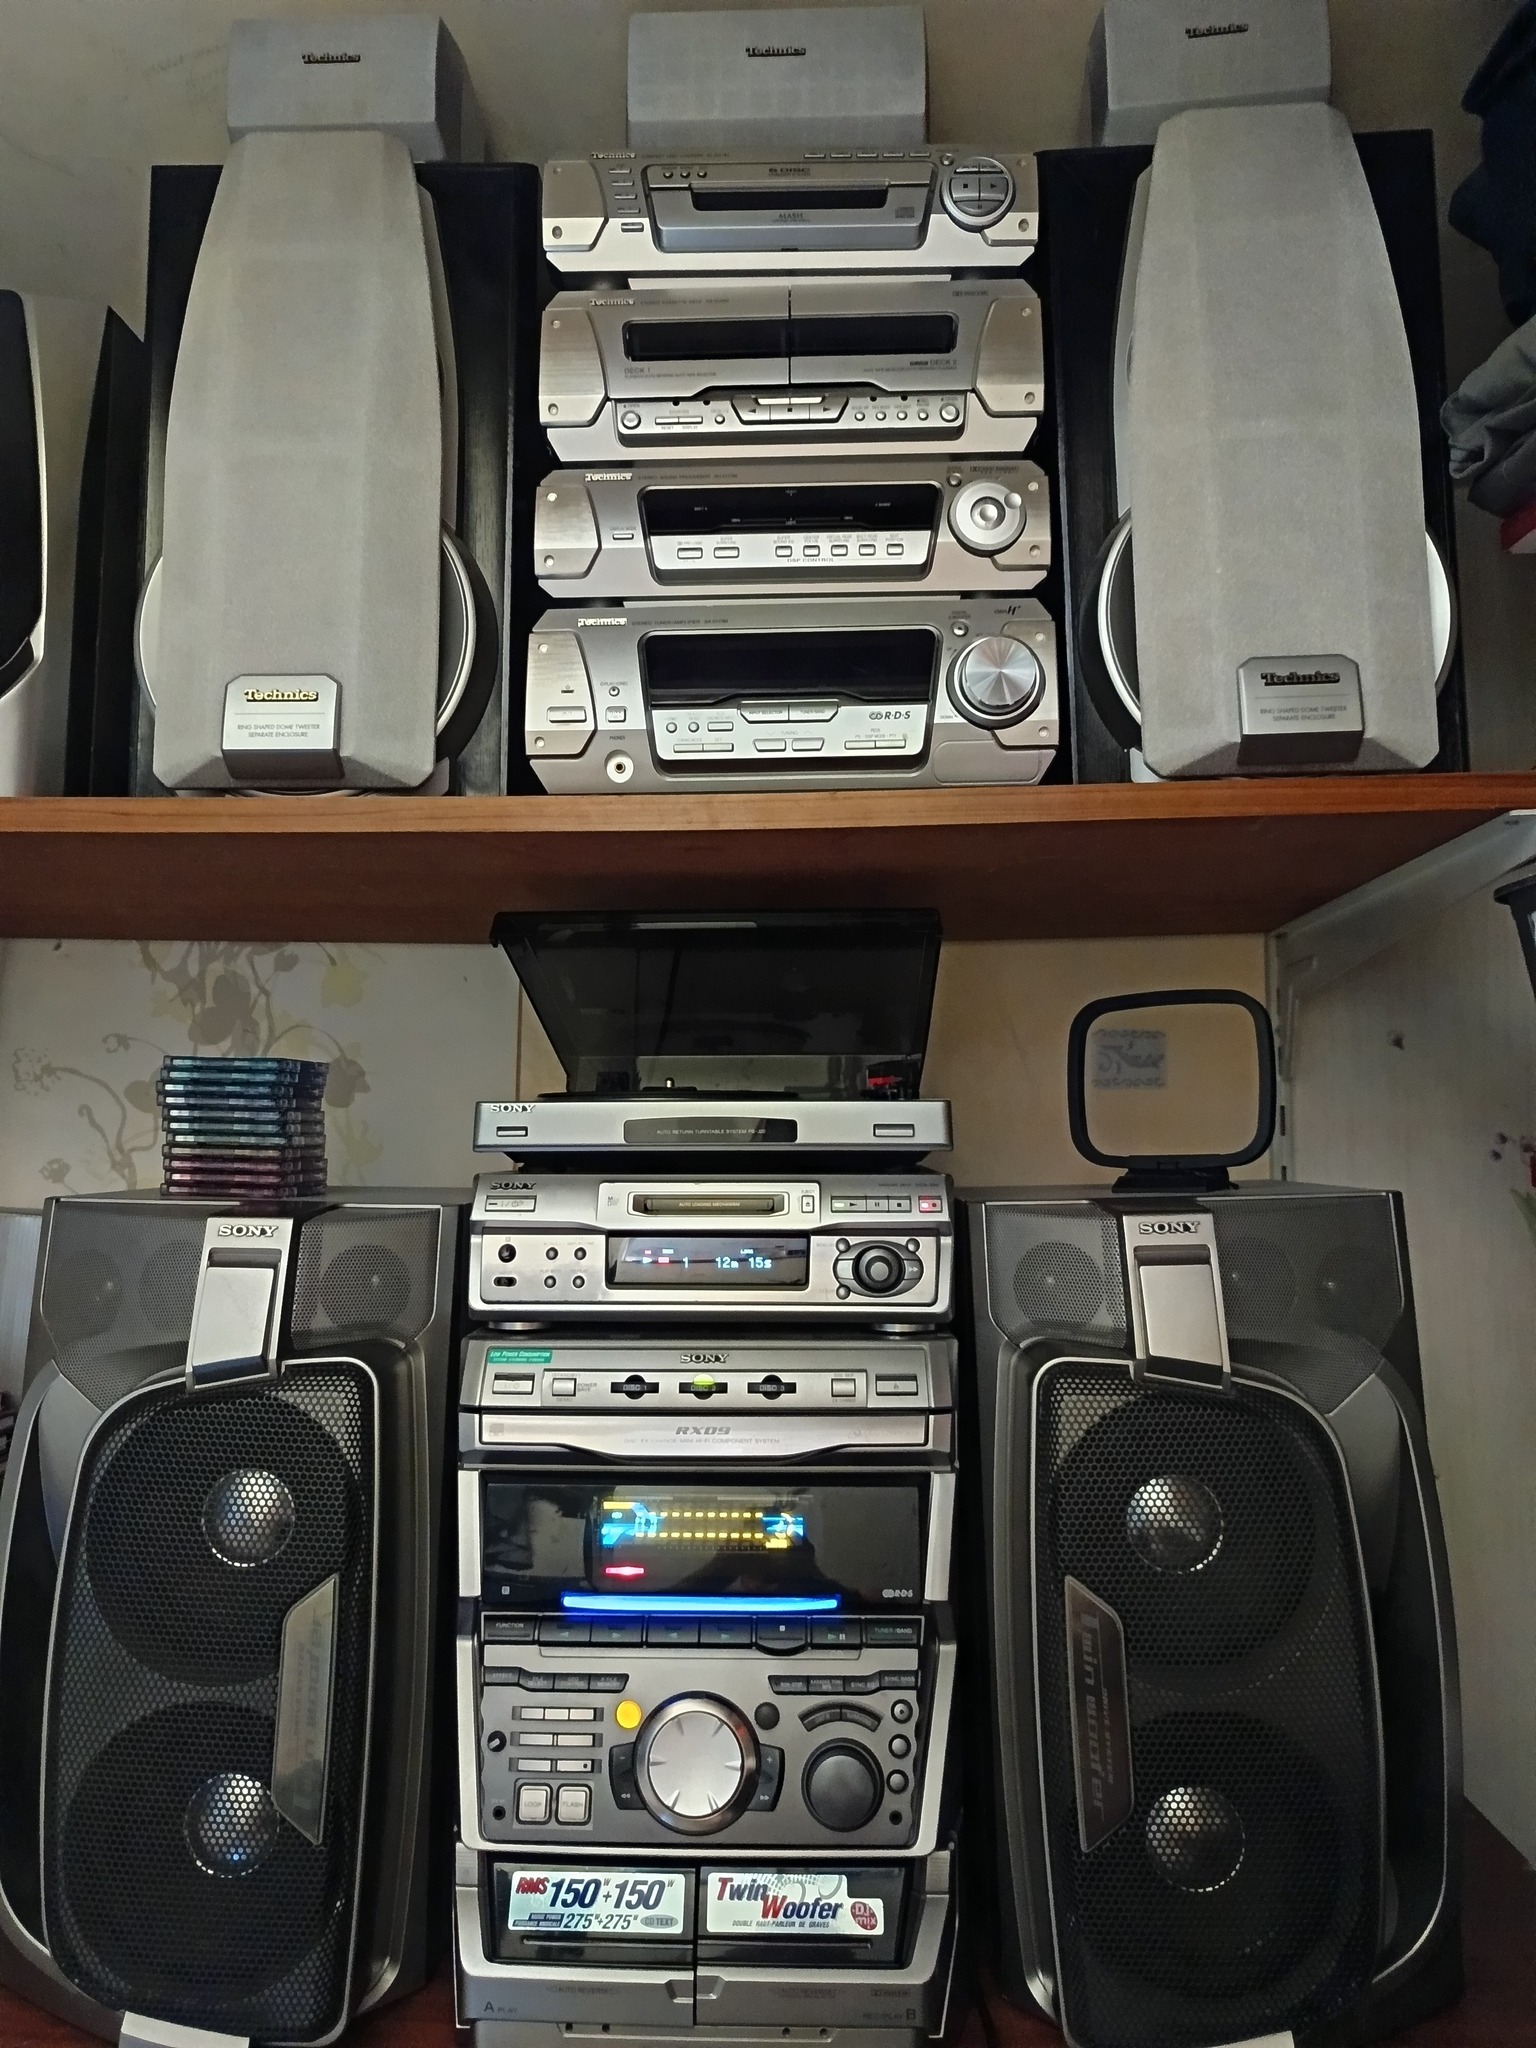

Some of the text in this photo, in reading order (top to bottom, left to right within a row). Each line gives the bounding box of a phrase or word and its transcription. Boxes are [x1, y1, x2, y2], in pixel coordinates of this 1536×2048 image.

[301, 51, 361, 64] Technics
[745, 46, 806, 57] Technics
[591, 151, 636, 160] Technics
[590, 298, 635, 307] Technics
[585, 472, 632, 482] Technics
[578, 617, 627, 627] Technics
[1261, 670, 1341, 687] Technics
[244, 688, 319, 702] Technics
[490, 1103, 536, 1113] SONY
[490, 1181, 536, 1190] SONY
[218, 1224, 278, 1237] SONY
[1138, 1220, 1201, 1234] SONY
[715, 1256, 739, 1269] 12m
[748, 1256, 772, 1269] 15s
[680, 1353, 729, 1363] SONY
[1080, 1612, 1106, 1819] Twin woofer
[716, 1877, 768, 1901] Twin
[760, 1894, 843, 1919] Woofer
[644, 1918, 674, 1926] CD TEXT
[558, 1986, 608, 1995] AUTO REVERSE
[484, 2001, 495, 2013] A
[906, 2008, 916, 2020] B
